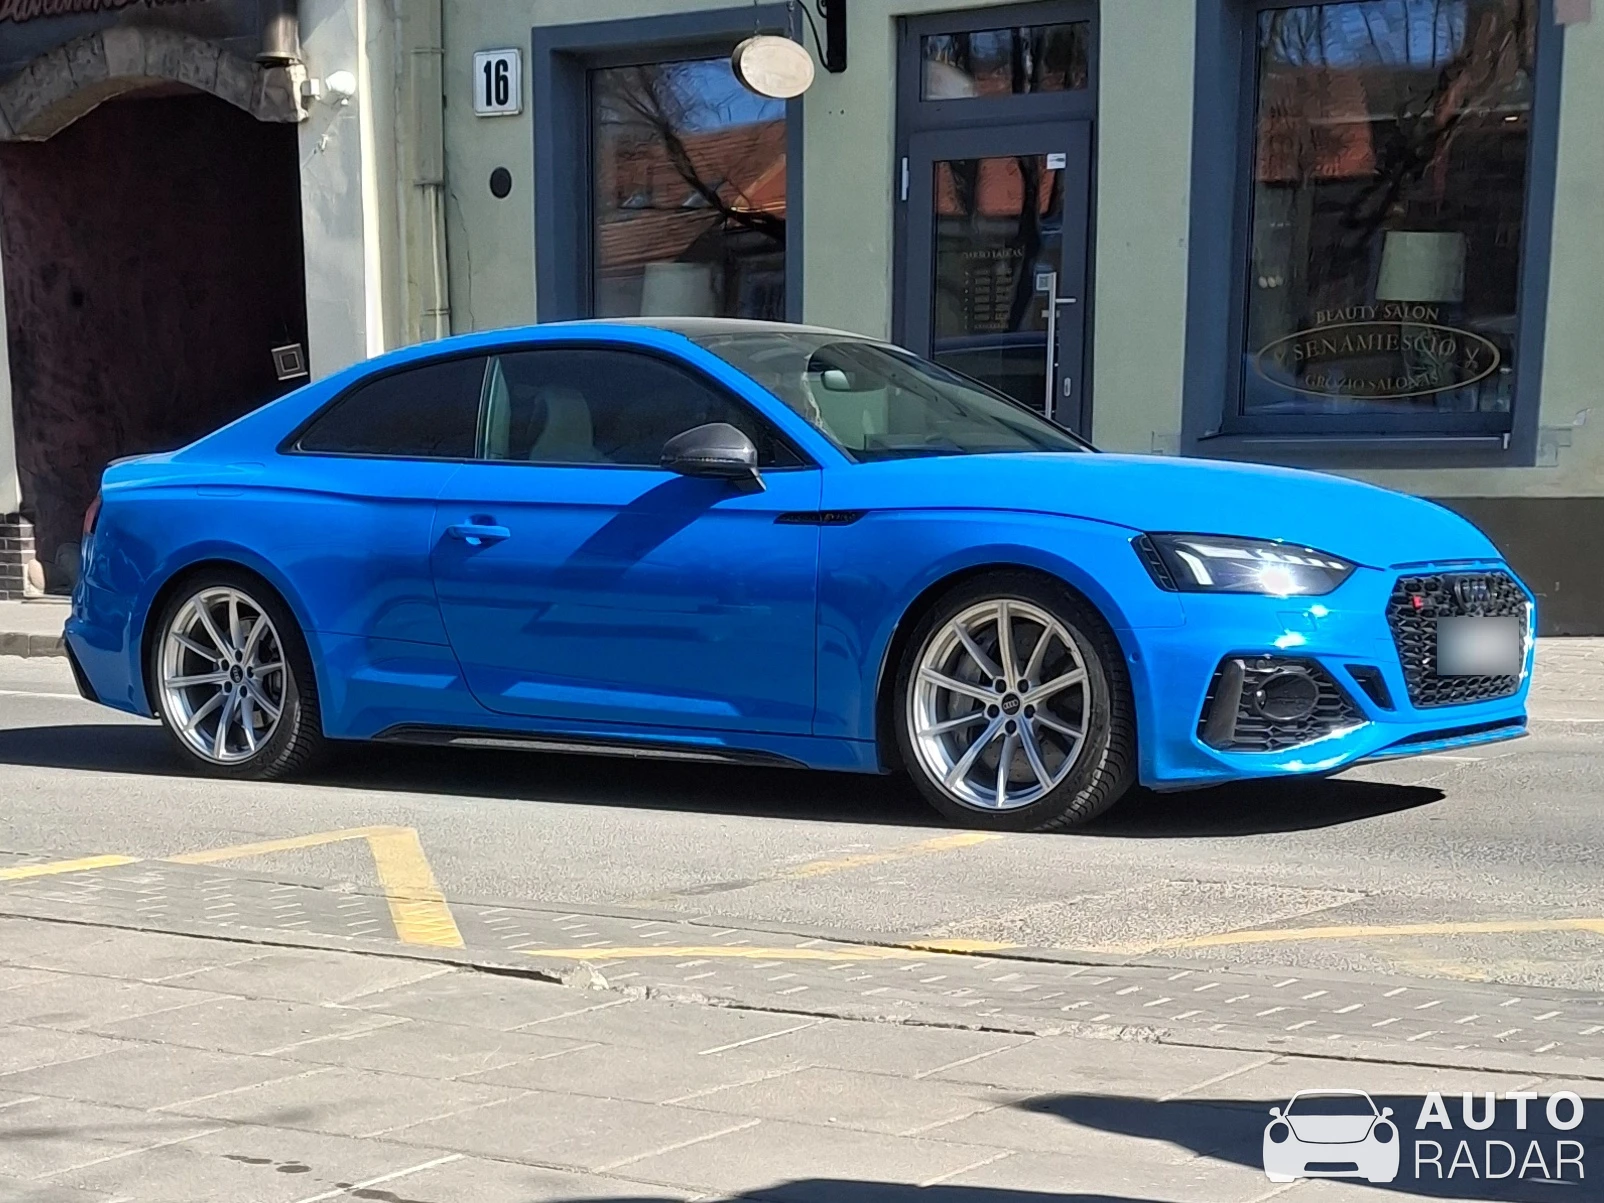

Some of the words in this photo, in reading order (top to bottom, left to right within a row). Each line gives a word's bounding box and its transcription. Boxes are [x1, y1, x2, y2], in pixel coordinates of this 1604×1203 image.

[484, 59, 509, 107] 16
[1316, 305, 1379, 324] BEAUTY
[1384, 303, 1440, 322] SALON
